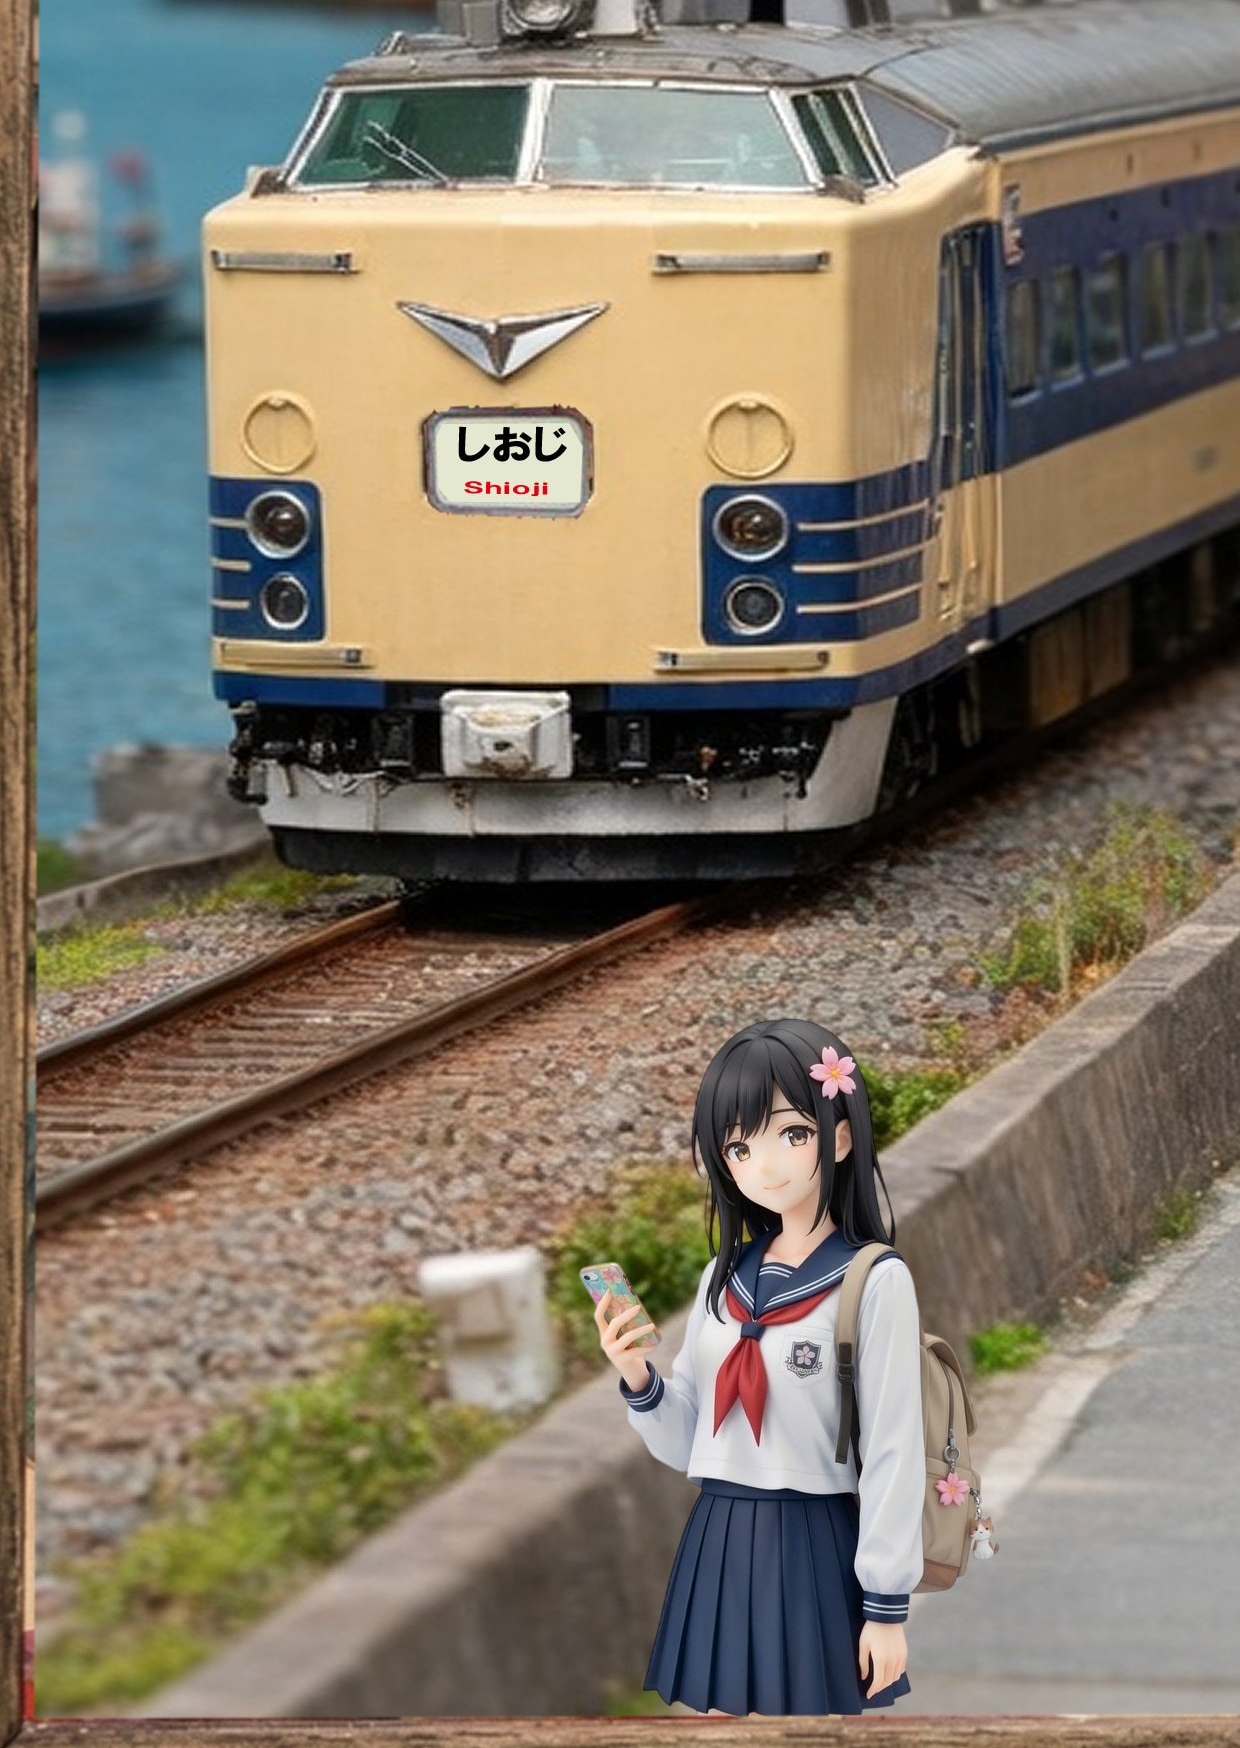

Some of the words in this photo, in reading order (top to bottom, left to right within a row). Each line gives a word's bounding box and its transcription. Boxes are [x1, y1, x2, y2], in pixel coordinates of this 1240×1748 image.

[457, 425, 568, 463] しおじ
[463, 479, 550, 497] Shioji
